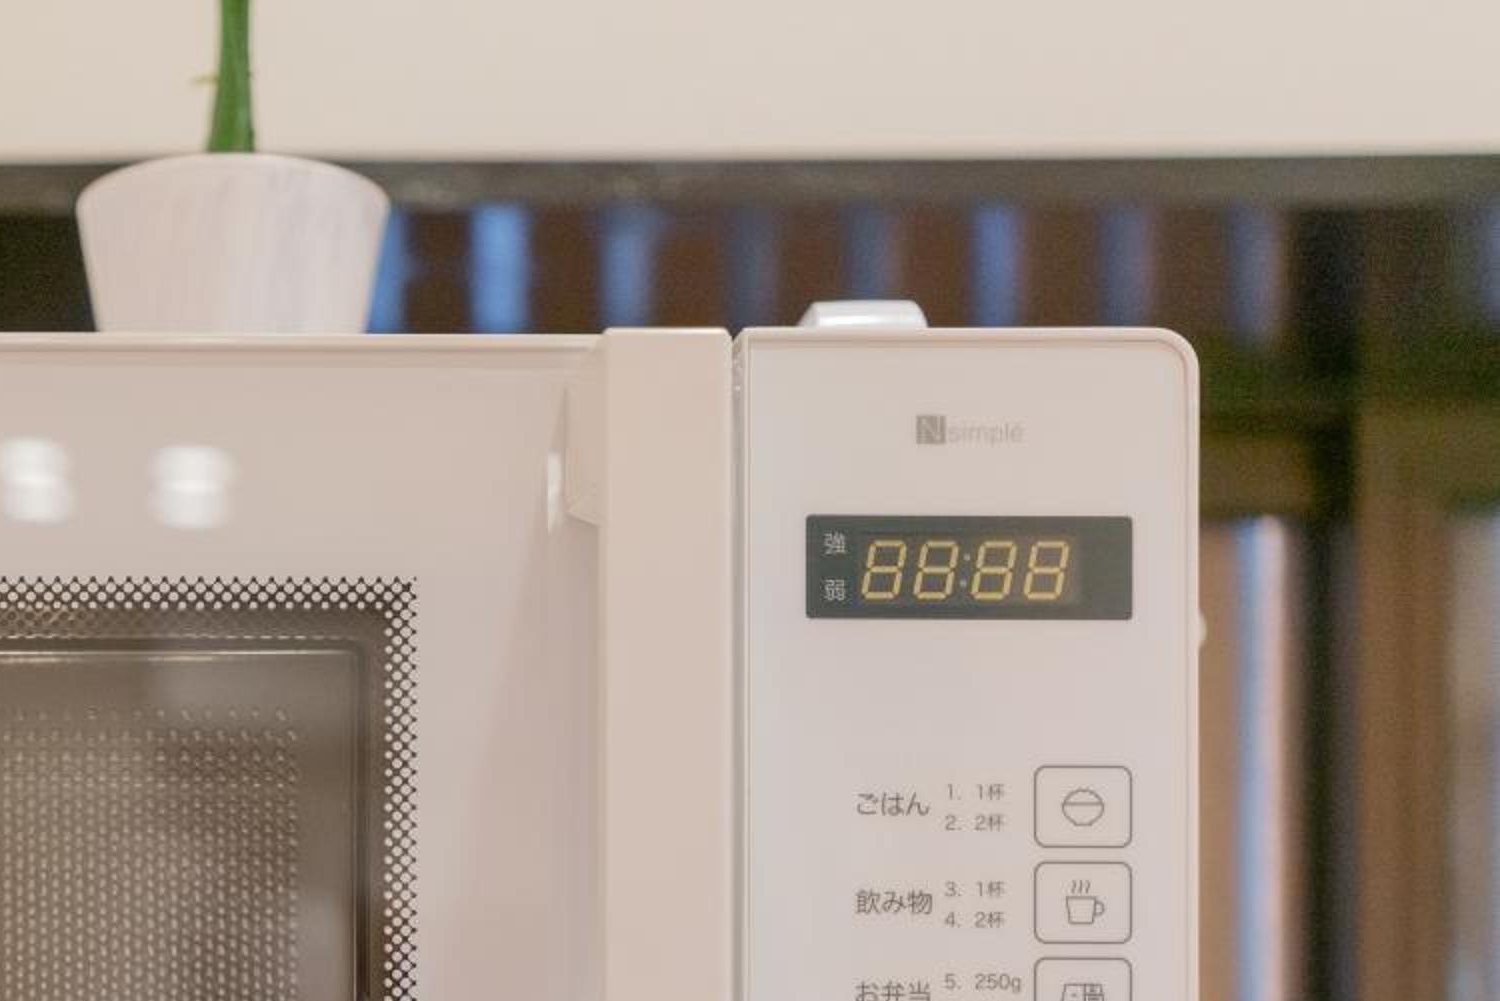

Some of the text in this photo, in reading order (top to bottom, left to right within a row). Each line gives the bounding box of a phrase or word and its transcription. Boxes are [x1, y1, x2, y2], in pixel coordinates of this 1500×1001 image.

[861, 540, 1071, 601] 88:88
[856, 792, 930, 817] ごはん
[855, 889, 933, 916] 飲み物
[974, 972, 1022, 993] 250g
